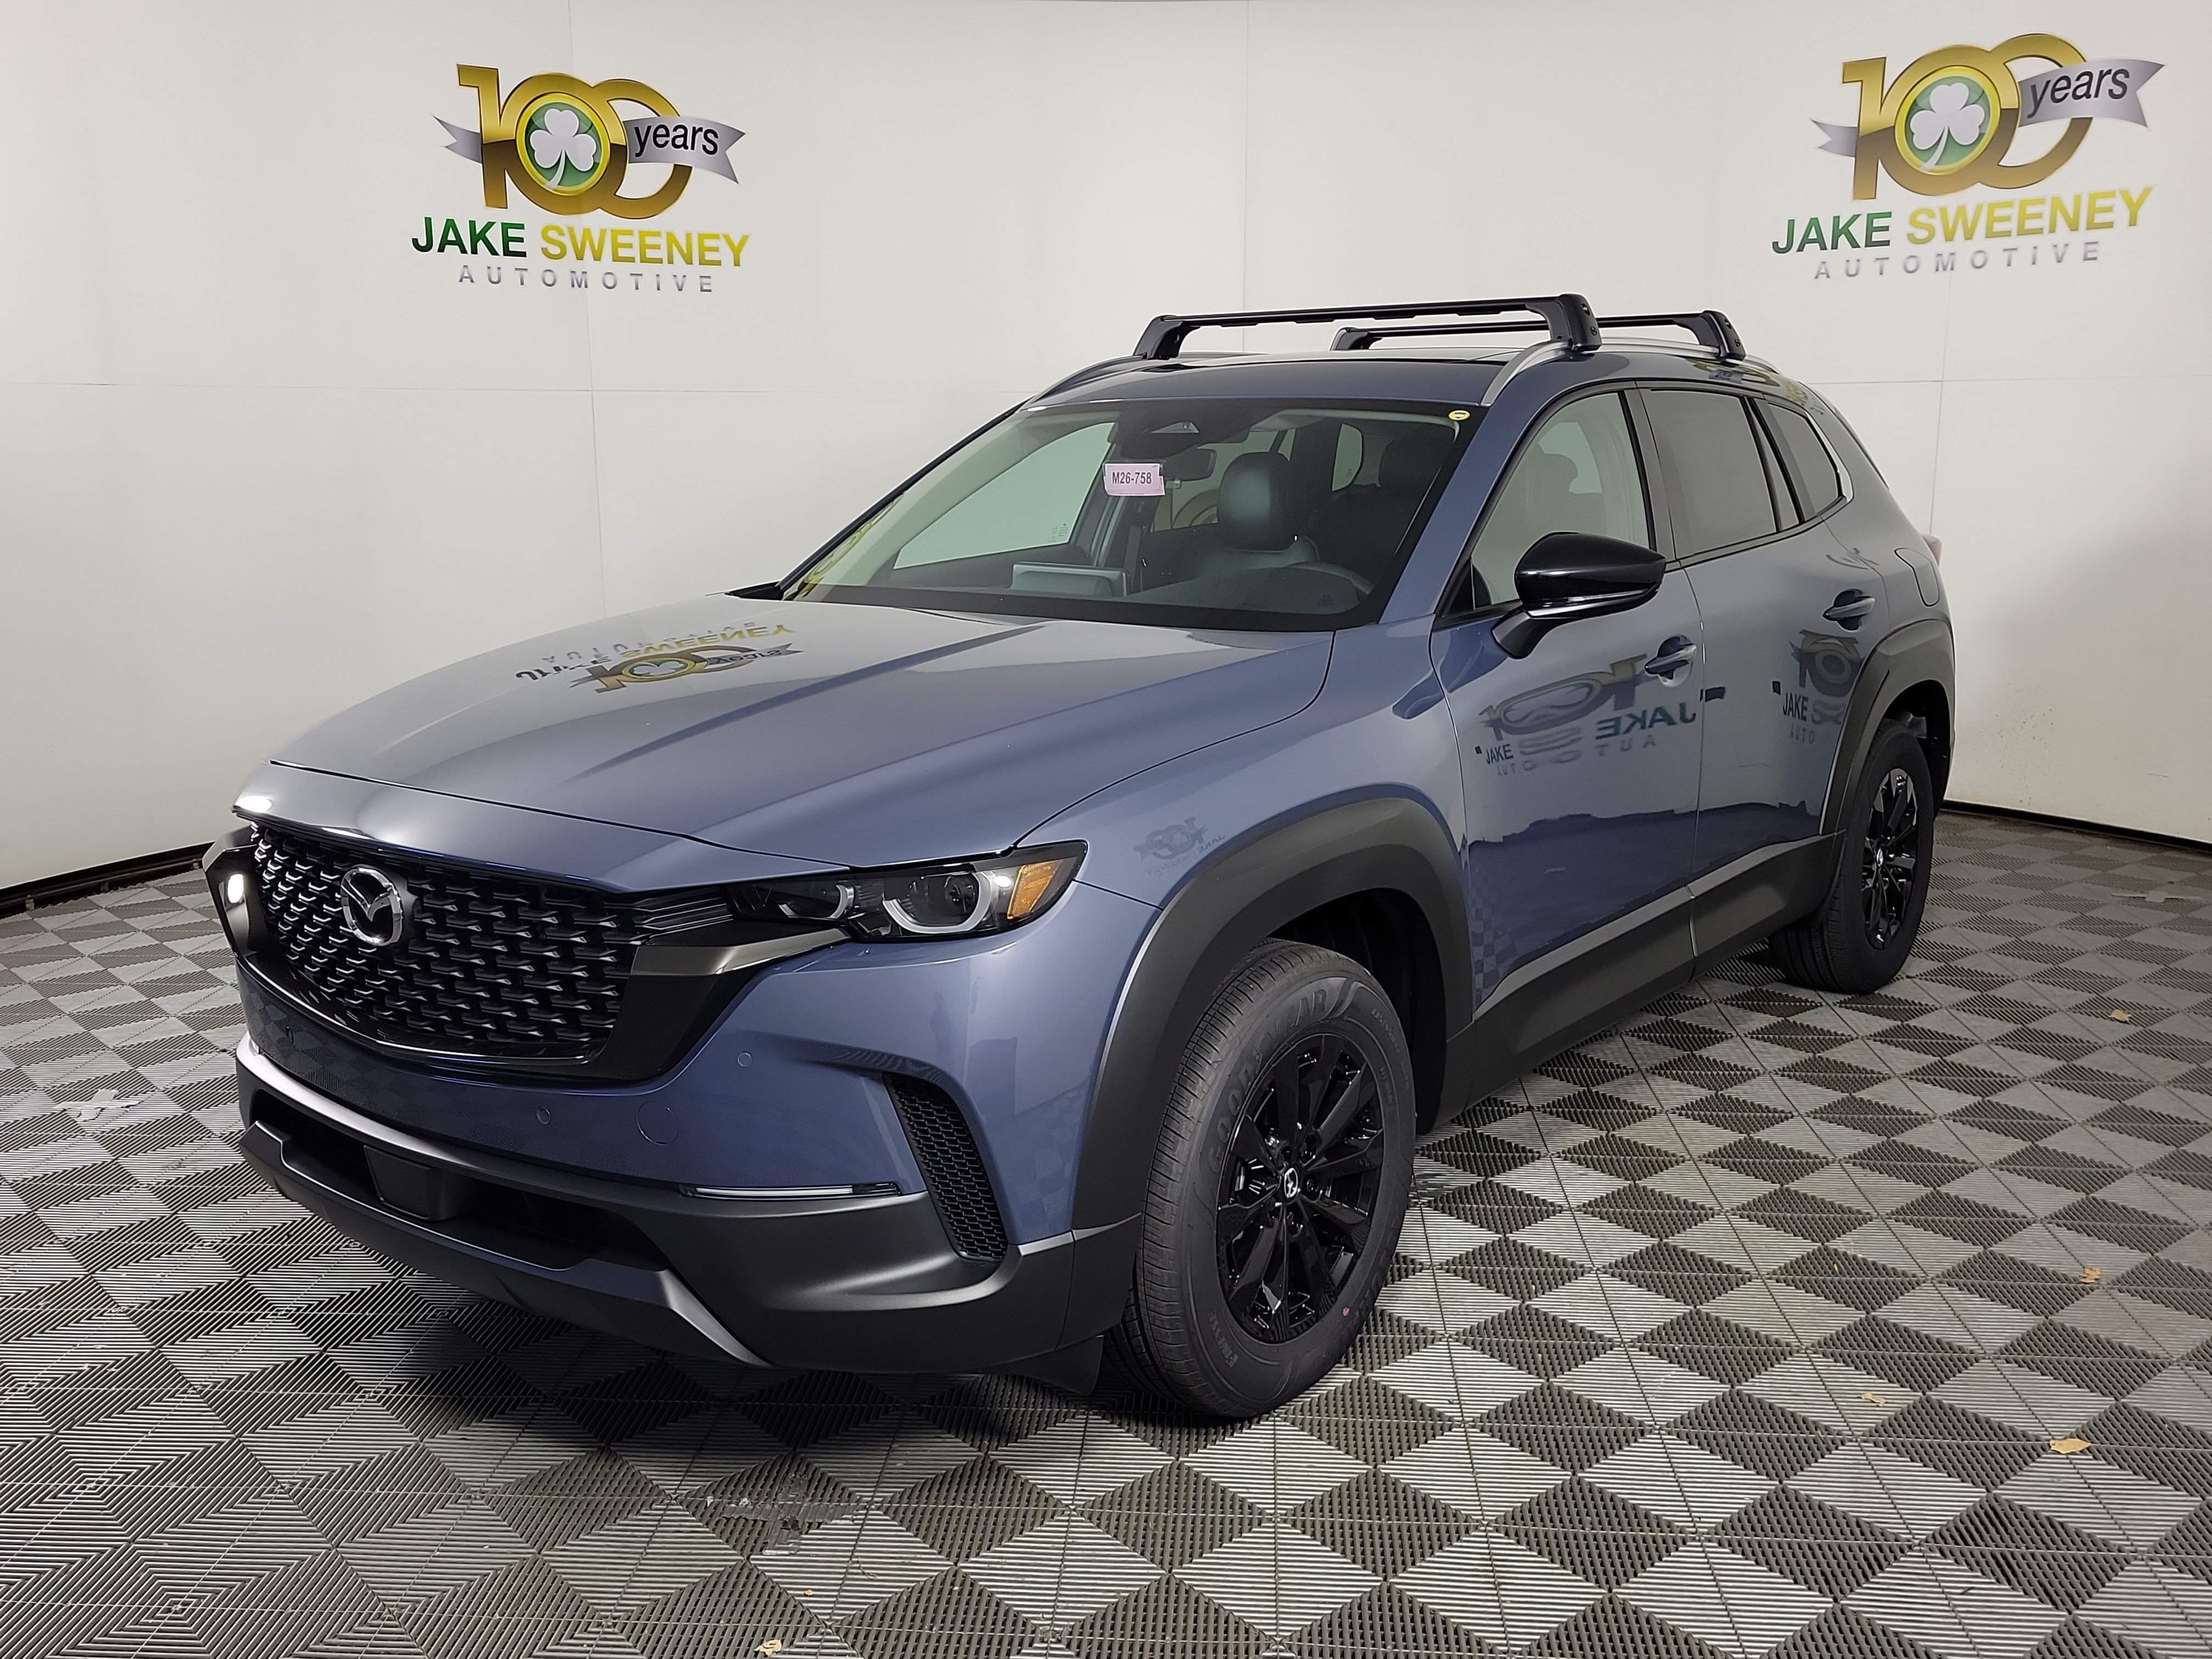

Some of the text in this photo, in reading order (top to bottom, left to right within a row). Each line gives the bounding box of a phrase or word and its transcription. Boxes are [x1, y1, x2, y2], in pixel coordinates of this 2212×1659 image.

[1841, 33, 2130, 200] 100 years
[456, 64, 719, 219] 100 years
[1771, 187, 2153, 254] JAKE SWEENEY
[411, 217, 750, 267] JAKE SWEENEY
[1814, 240, 2099, 280] AUTOMOTIVE
[459, 264, 712, 292] AUTOMOTIVE
[1112, 471, 1152, 484] M26-758
[1783, 692, 1808, 722] JAKE
[1486, 743, 1514, 765] JAKE
